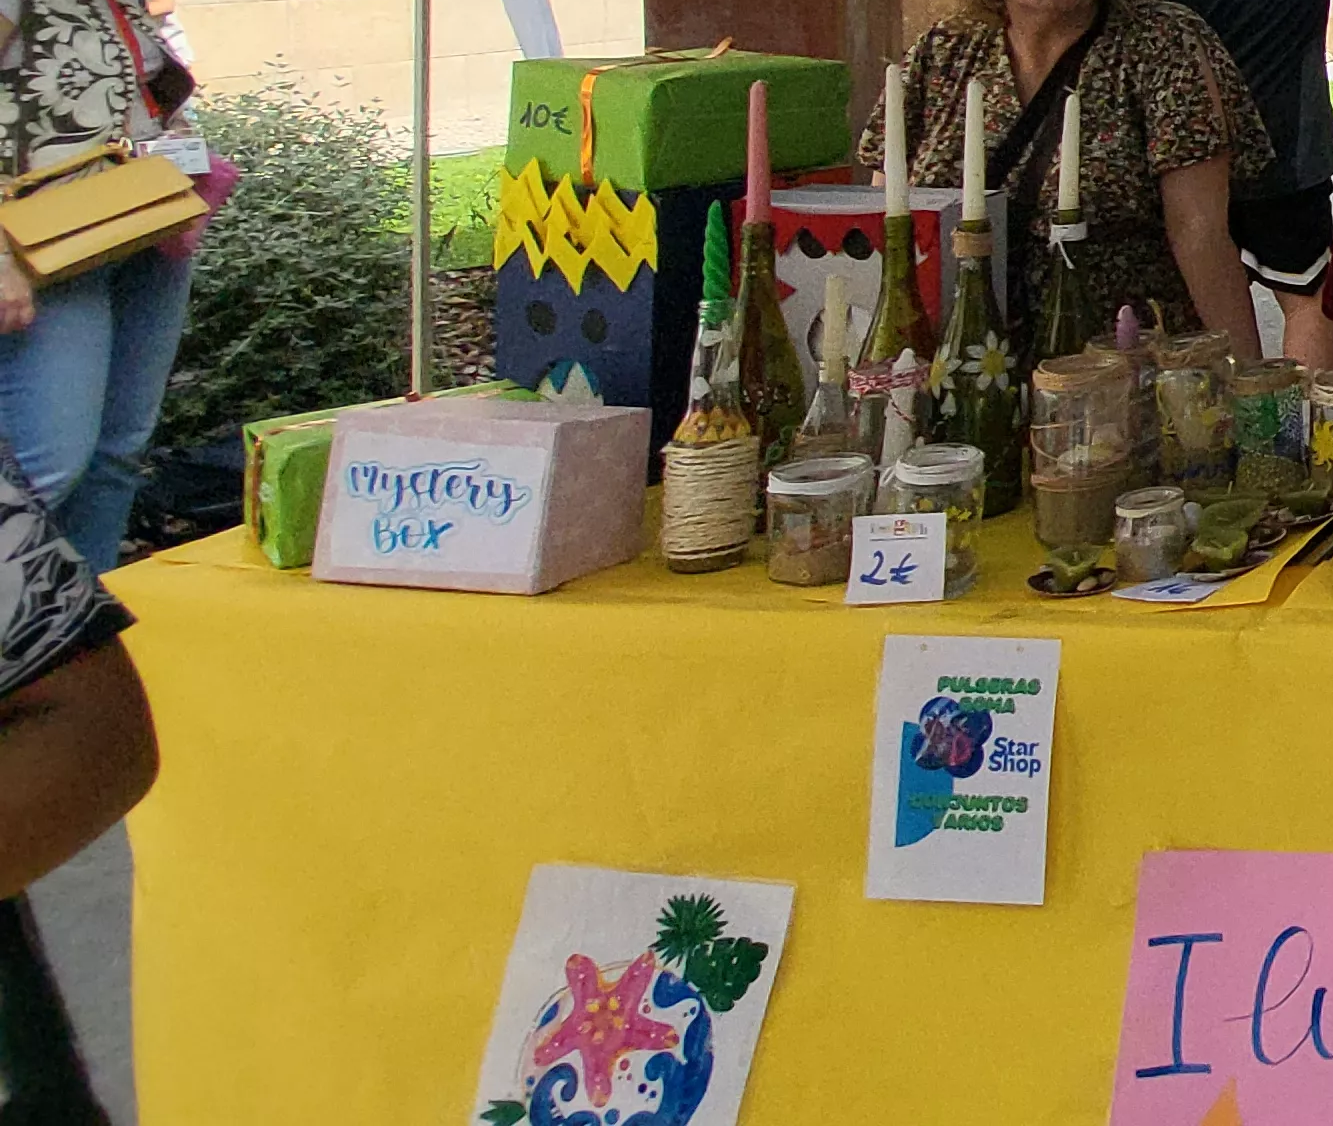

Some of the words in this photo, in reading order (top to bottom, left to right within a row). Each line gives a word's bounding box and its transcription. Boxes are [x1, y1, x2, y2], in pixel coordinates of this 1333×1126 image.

[348, 460, 530, 518] Mystery
[937, 675, 1042, 696] PULSERAS
[993, 736, 1040, 757] Star
[988, 753, 1042, 779] Shop
